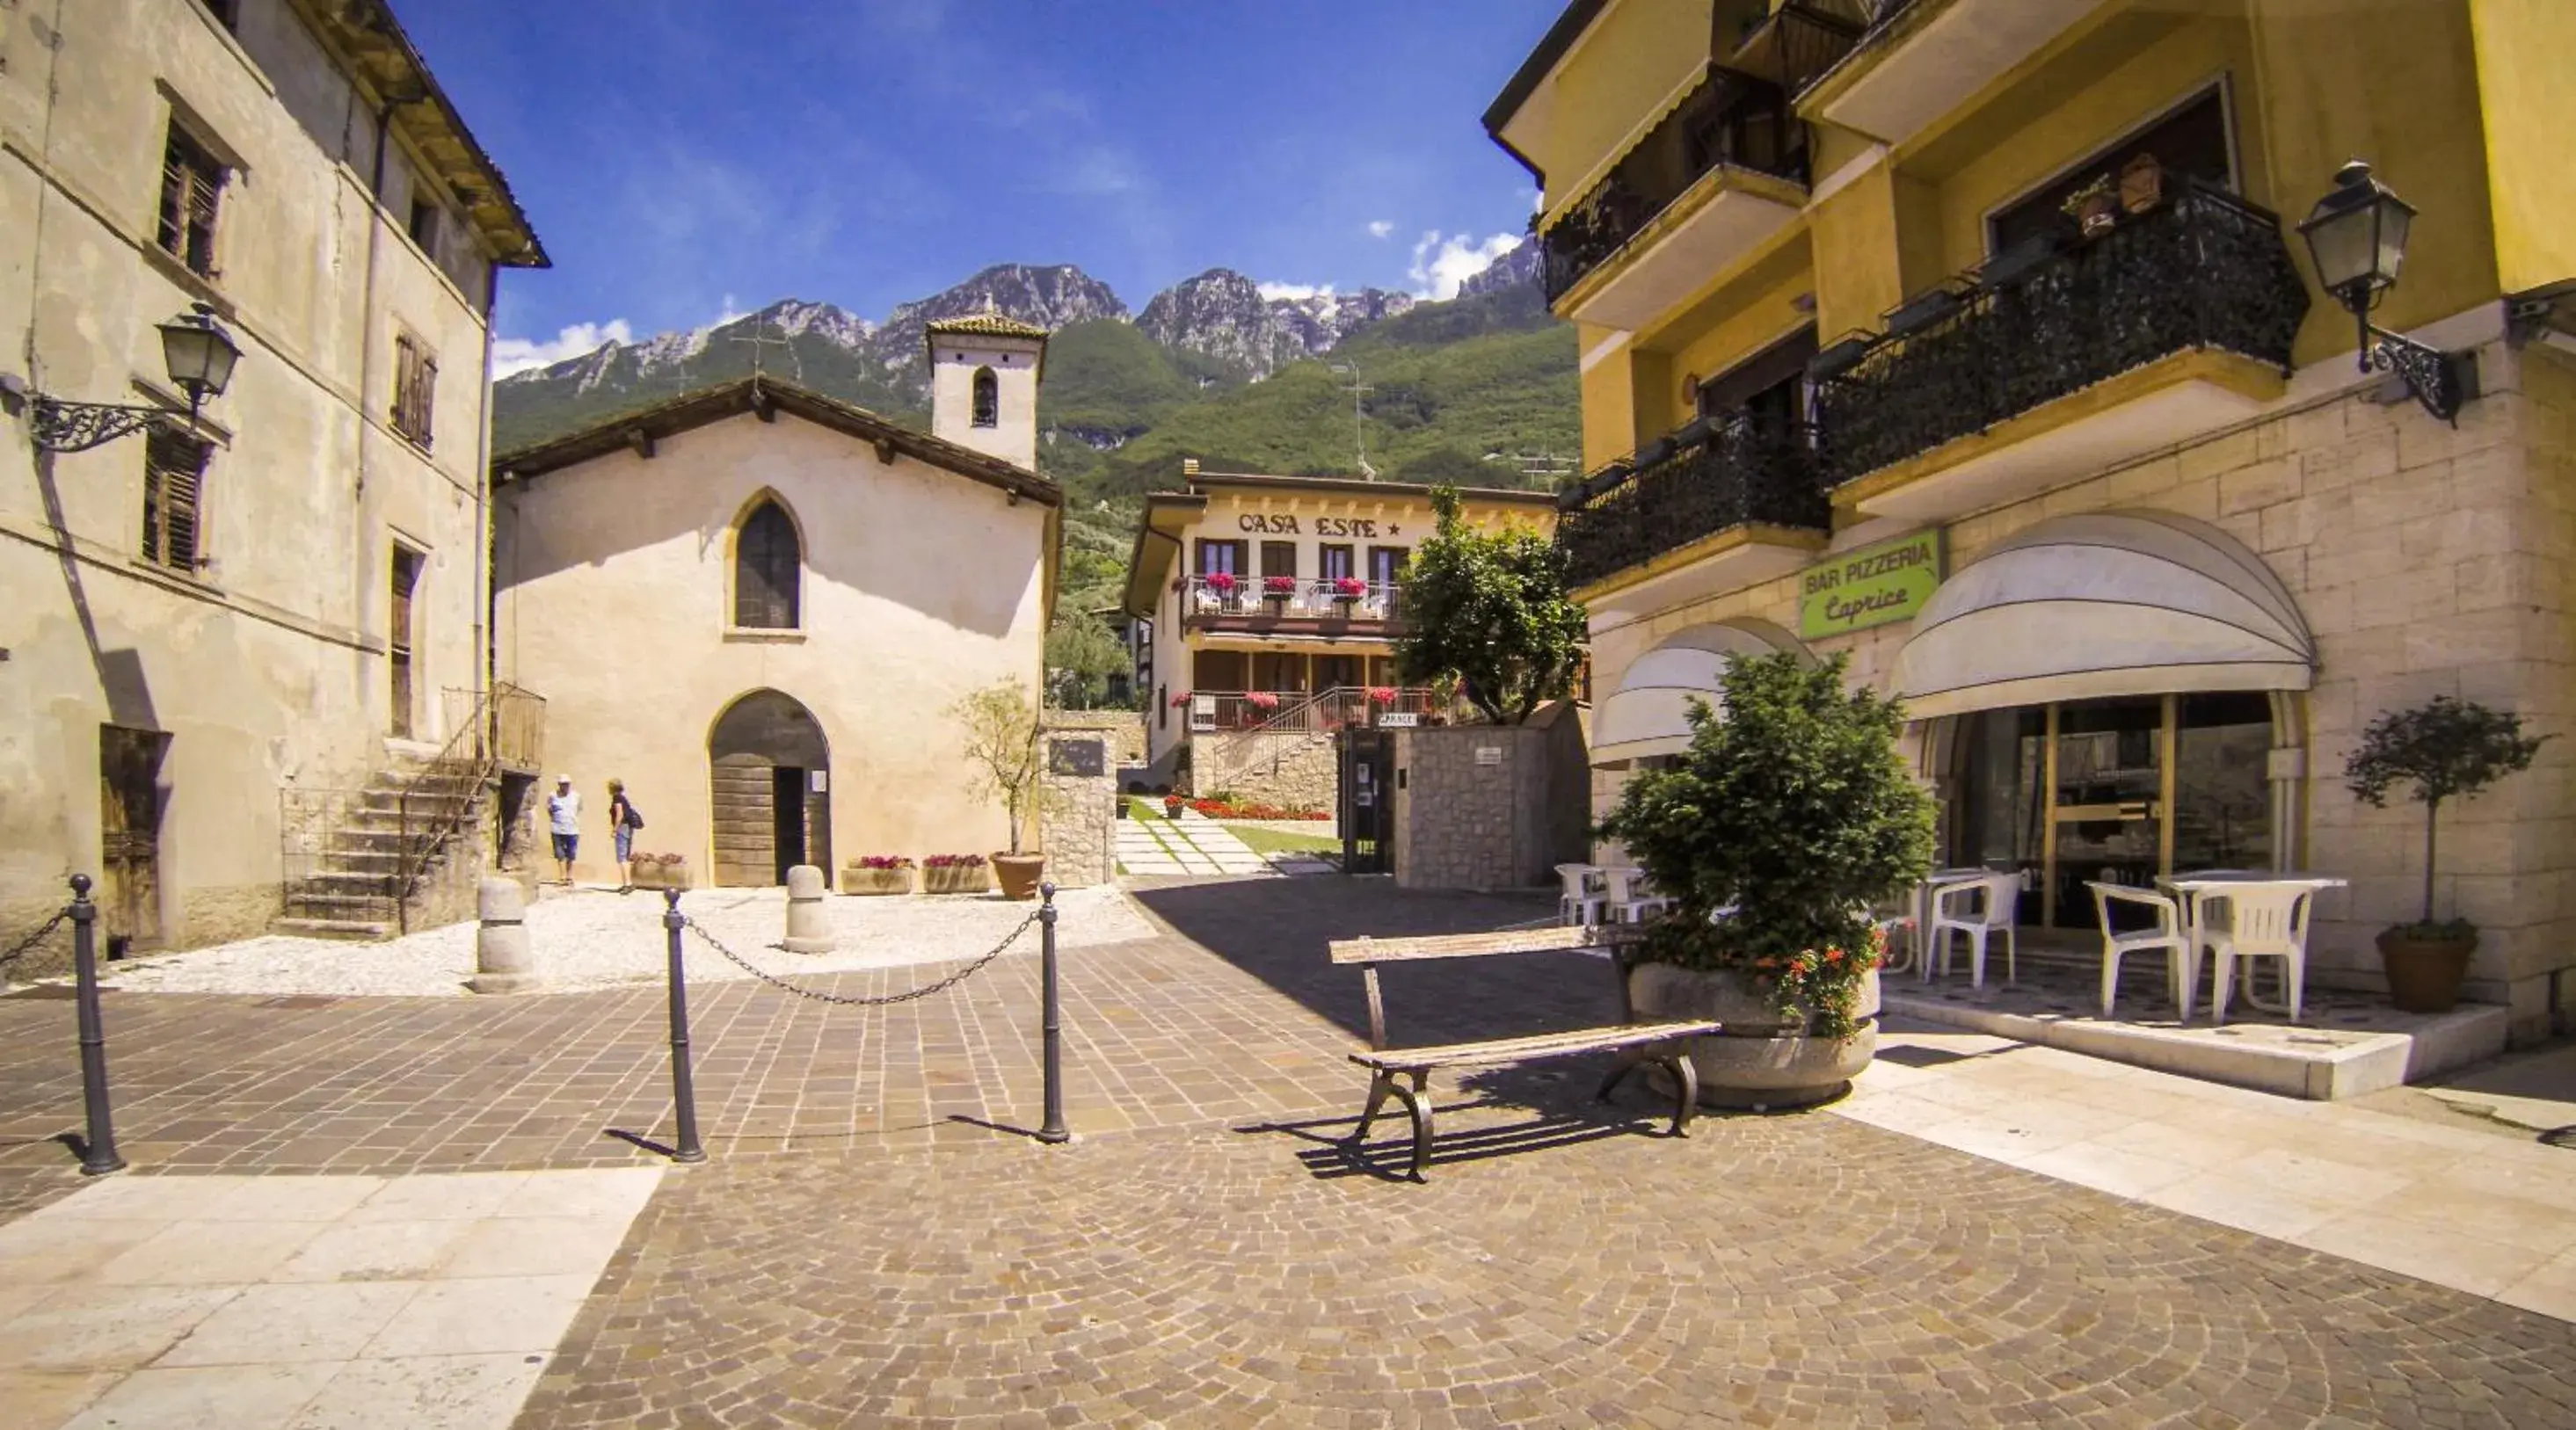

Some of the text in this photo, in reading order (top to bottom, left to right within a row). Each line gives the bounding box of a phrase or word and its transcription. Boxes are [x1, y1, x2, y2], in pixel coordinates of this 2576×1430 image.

[1239, 514, 1378, 538] CASA ESTE
[1805, 541, 1932, 594] BAR PIZZERIA
[1824, 588, 1908, 625] Caprice
